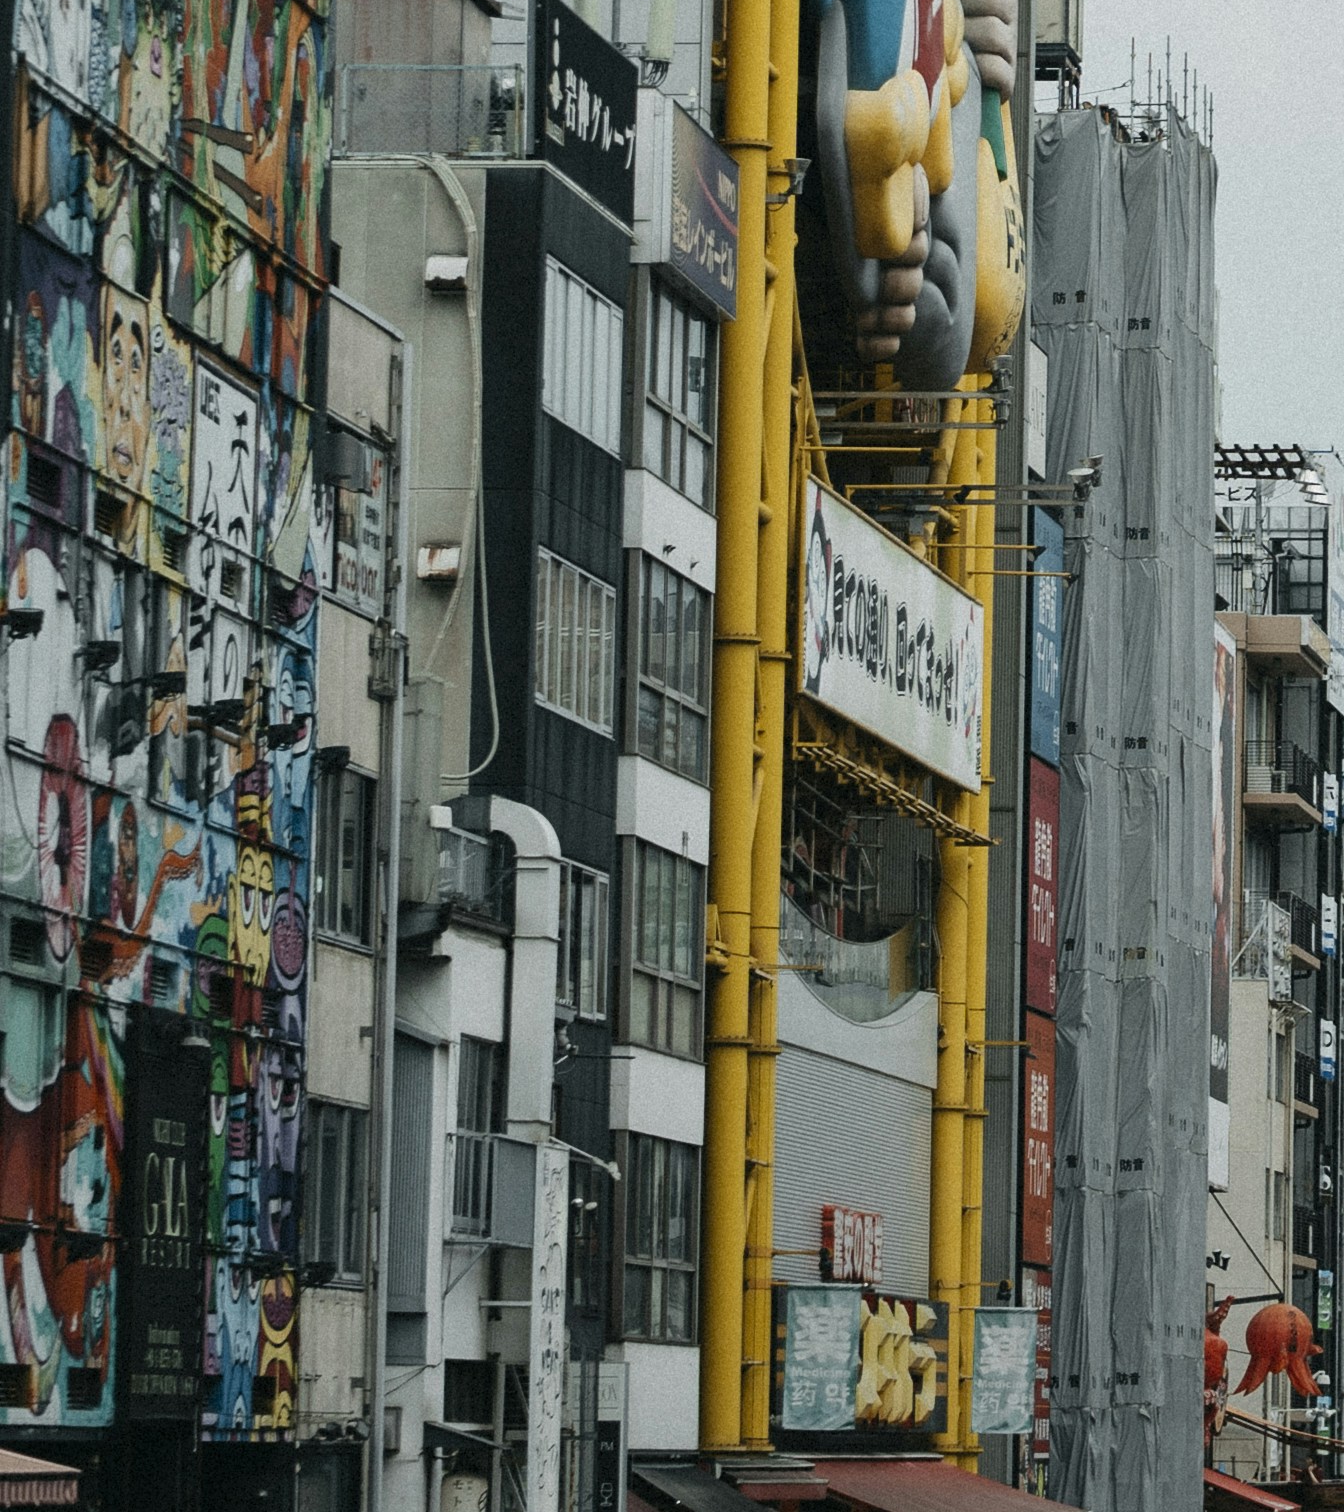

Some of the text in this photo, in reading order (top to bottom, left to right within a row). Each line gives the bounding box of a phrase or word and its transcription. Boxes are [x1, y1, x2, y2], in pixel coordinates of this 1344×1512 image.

[1052, 290, 1087, 306] 防音
[1127, 317, 1152, 334] 防音
[1125, 527, 1150, 541] 防音
[1124, 737, 1148, 751] 防音
[1120, 1158, 1144, 1174] 防音
[790, 1365, 851, 1379] Medicine
